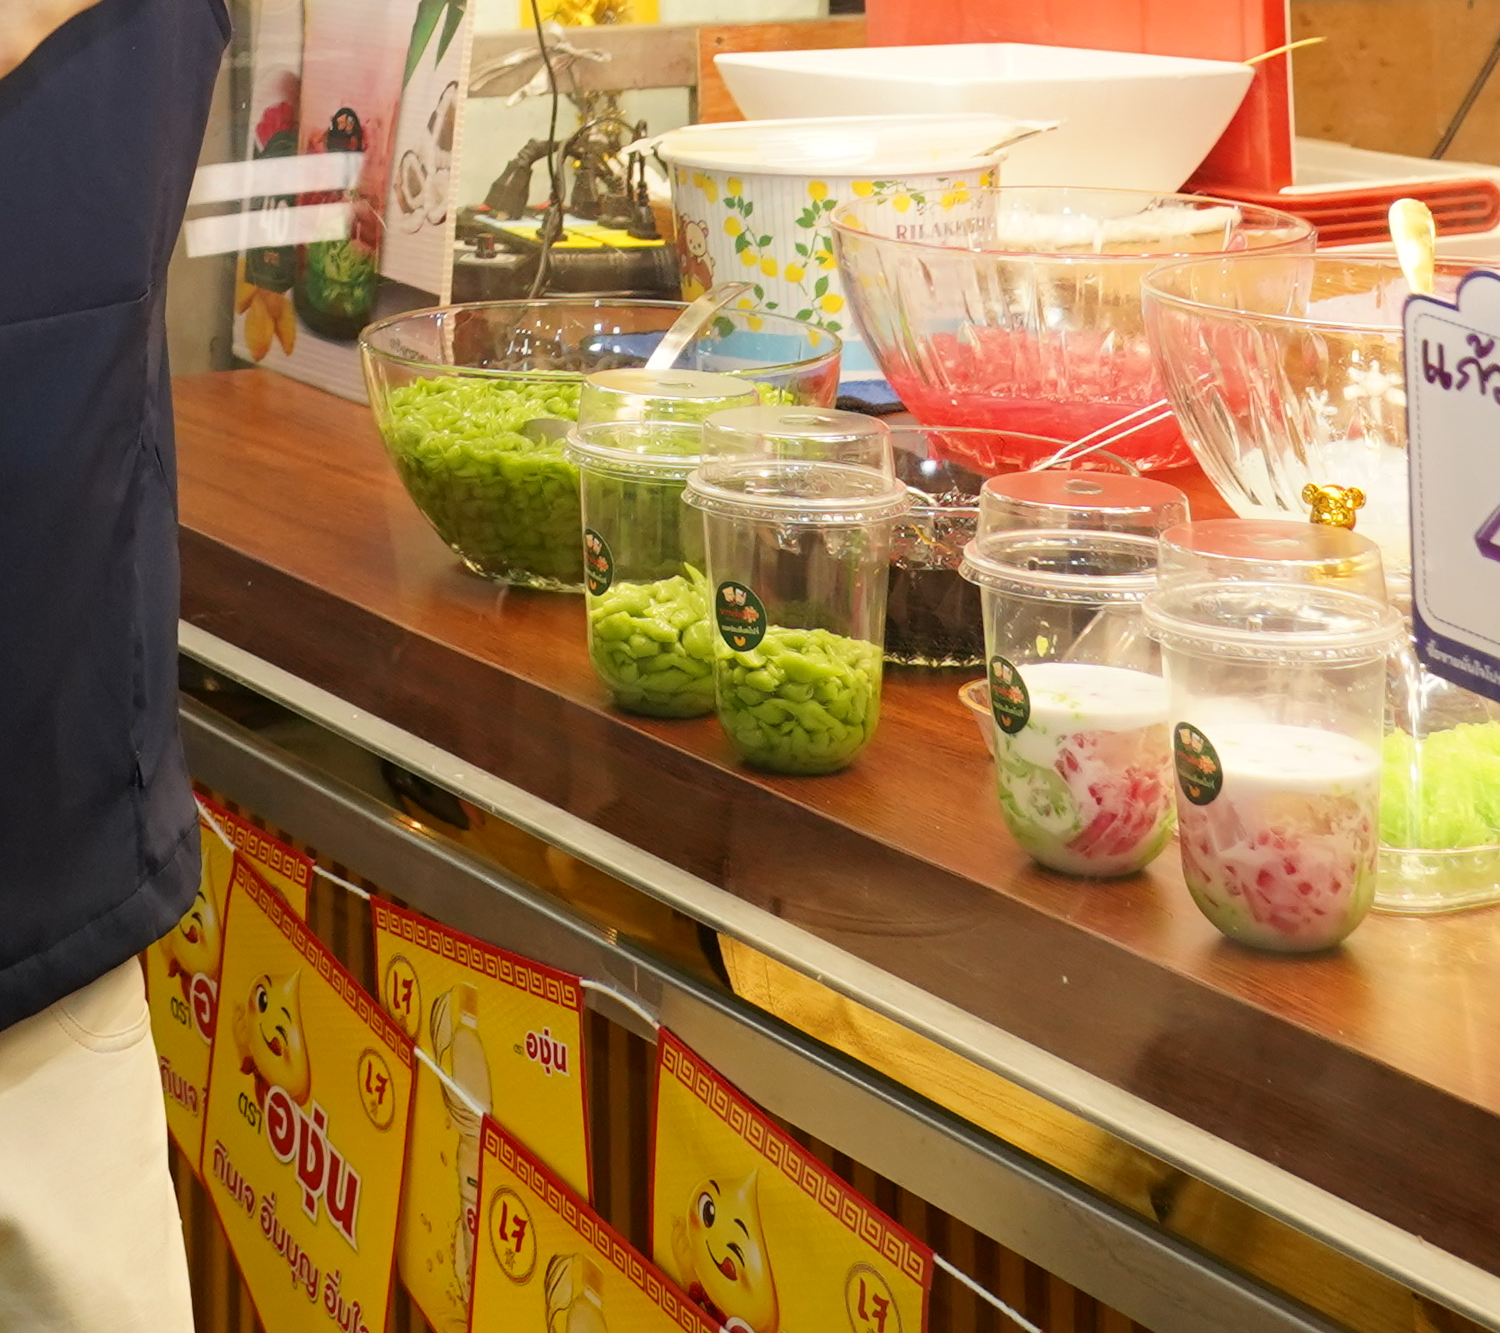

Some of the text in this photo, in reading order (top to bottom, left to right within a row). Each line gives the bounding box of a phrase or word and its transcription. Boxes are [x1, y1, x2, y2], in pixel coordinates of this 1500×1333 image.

[170, 996, 192, 1030] ตรา
[393, 969, 415, 1017] เจ
[525, 1026, 569, 1076] องุ่น
[365, 1058, 390, 1107] เจ
[237, 1086, 361, 1247] ตรา องุ่น
[212, 1138, 257, 1219] กินเจ
[259, 1191, 321, 1304] อิ่มบุญ
[498, 1199, 528, 1254] เจ
